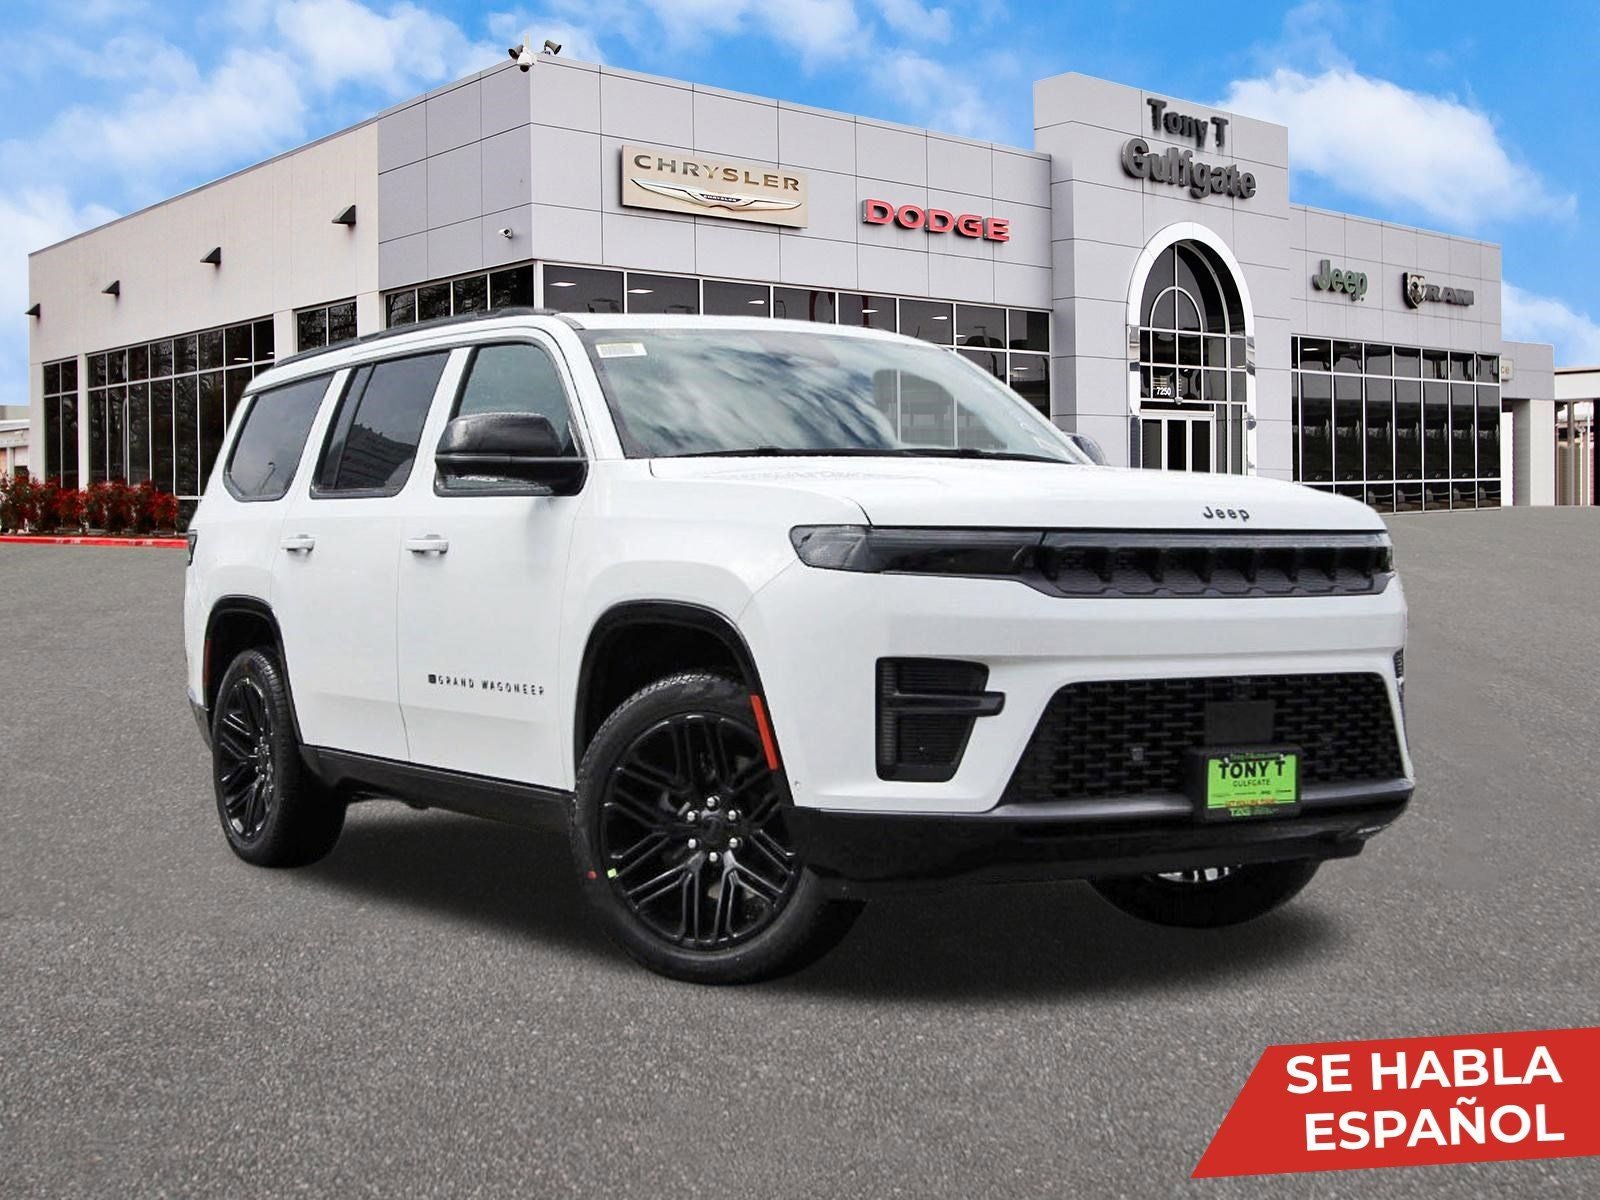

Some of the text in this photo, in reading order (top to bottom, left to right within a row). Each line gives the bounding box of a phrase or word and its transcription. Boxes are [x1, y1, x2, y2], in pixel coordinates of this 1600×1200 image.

[1146, 98, 1229, 148] Tony T
[633, 154, 800, 192] CHRYSLER
[1121, 137, 1257, 199] Gulfgate
[862, 198, 1011, 242] DODGE
[1312, 259, 1368, 302] Jeep
[1425, 284, 1475, 307] RAM
[1156, 387, 1172, 396] 7250
[1203, 506, 1250, 522] Jeep
[438, 675, 475, 688] GRAND
[1218, 760, 1286, 779] TONY T
